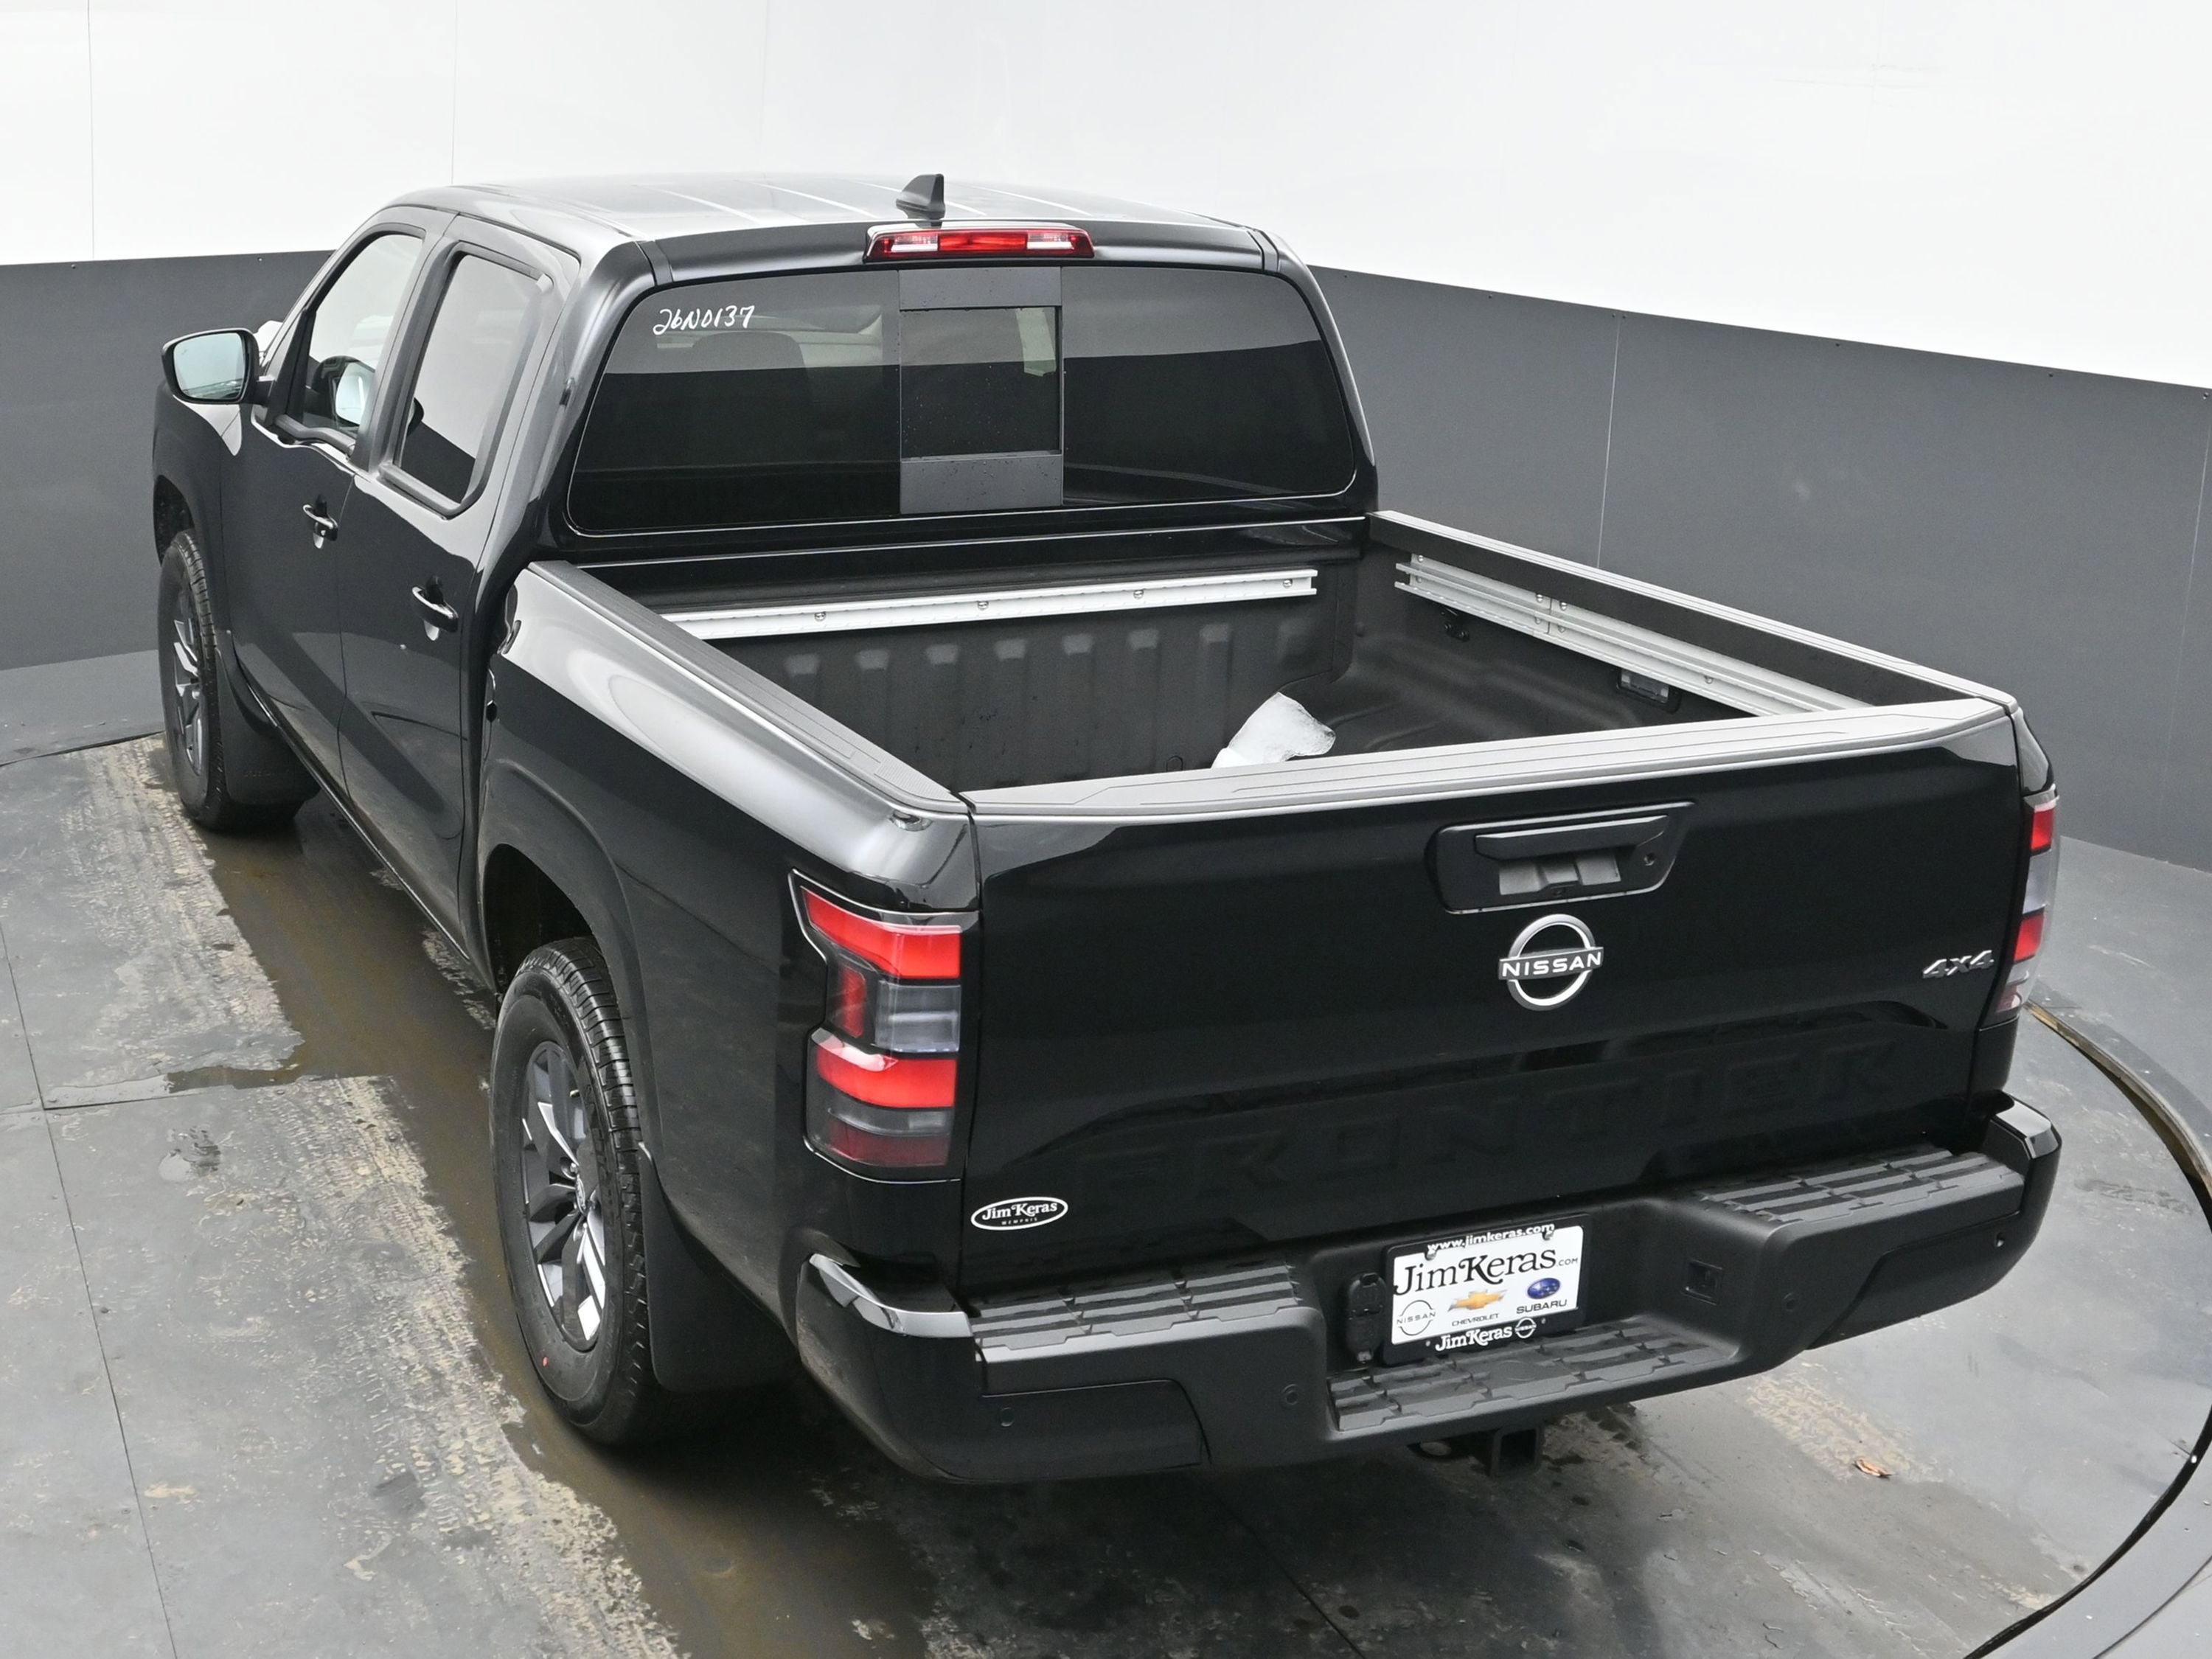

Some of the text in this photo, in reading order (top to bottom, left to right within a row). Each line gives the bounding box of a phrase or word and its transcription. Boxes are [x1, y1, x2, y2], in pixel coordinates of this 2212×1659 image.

[1502, 951, 1601, 977] NISSAN
[1427, 1223, 1555, 1251] www.jimkeras.com
[1516, 1299, 1567, 1314] SUBARU
[1397, 1311, 1436, 1325] NISSAN
[1451, 1313, 1500, 1326] CHEVROLET
